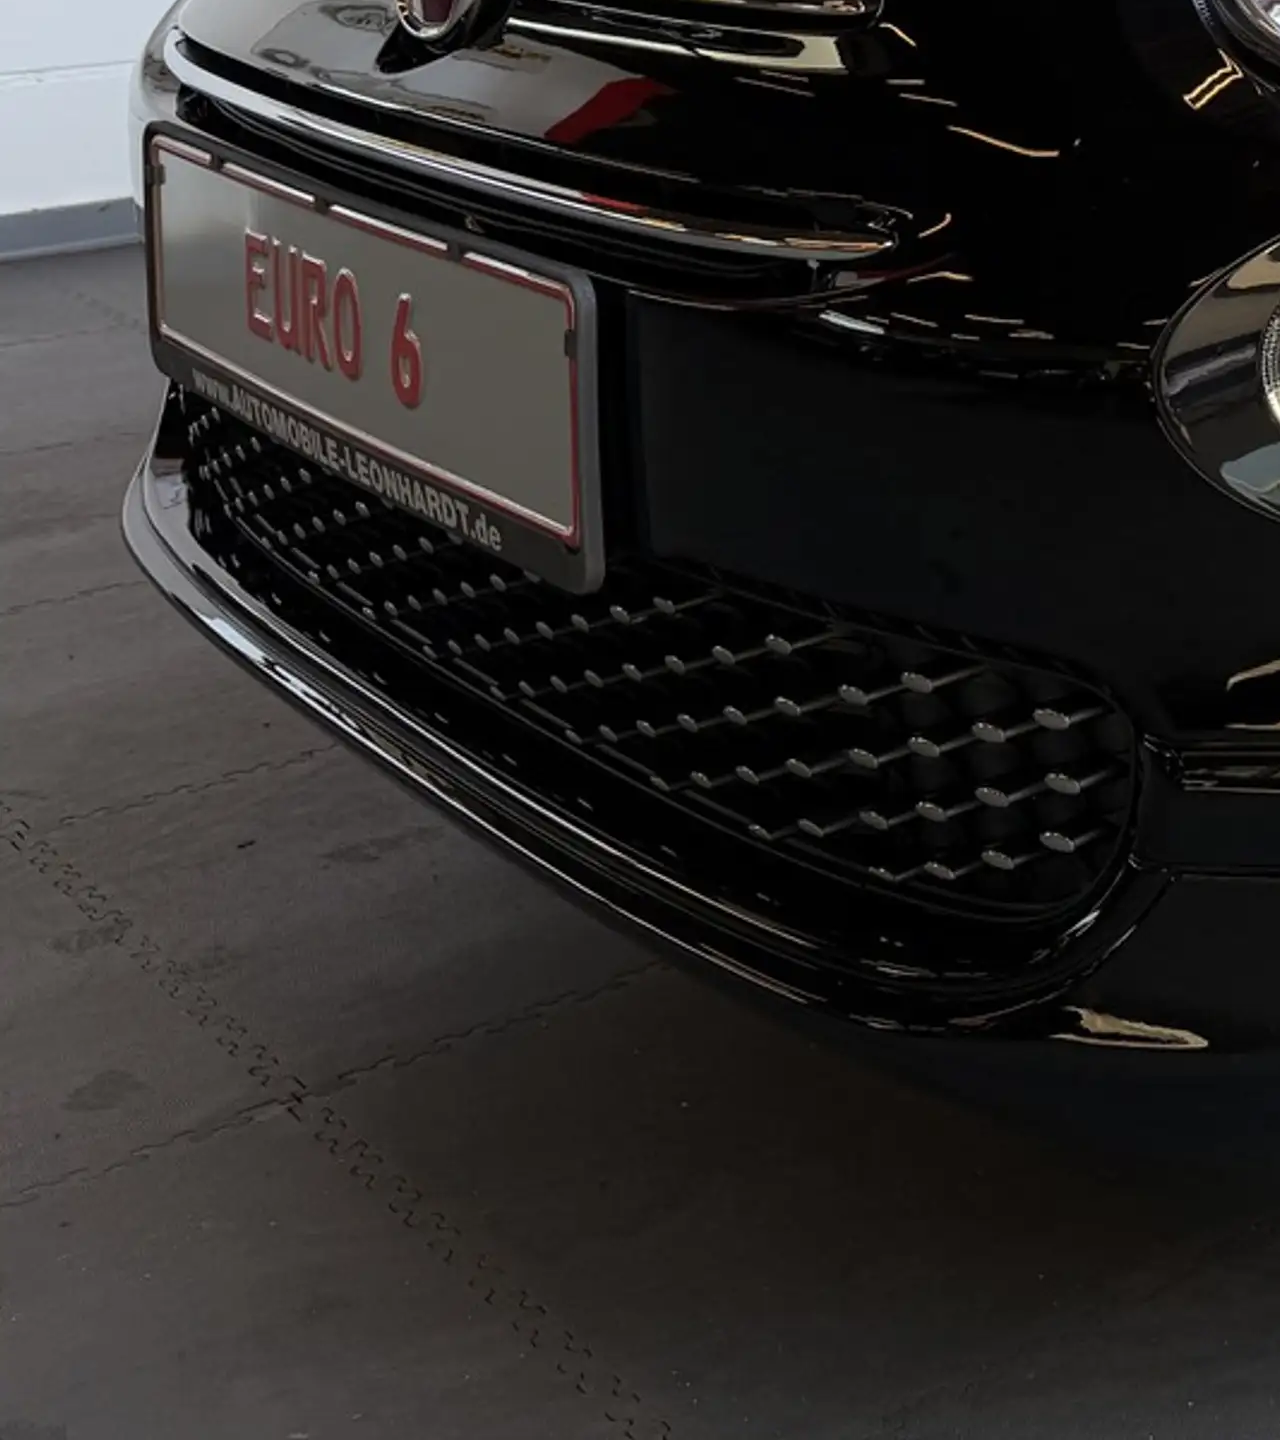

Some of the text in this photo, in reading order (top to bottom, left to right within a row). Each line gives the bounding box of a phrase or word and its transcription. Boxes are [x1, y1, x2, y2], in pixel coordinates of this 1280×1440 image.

[242, 225, 424, 410] EURO 6
[191, 368, 503, 552] www.AUTOMOBILE-LEONHARDT.de
